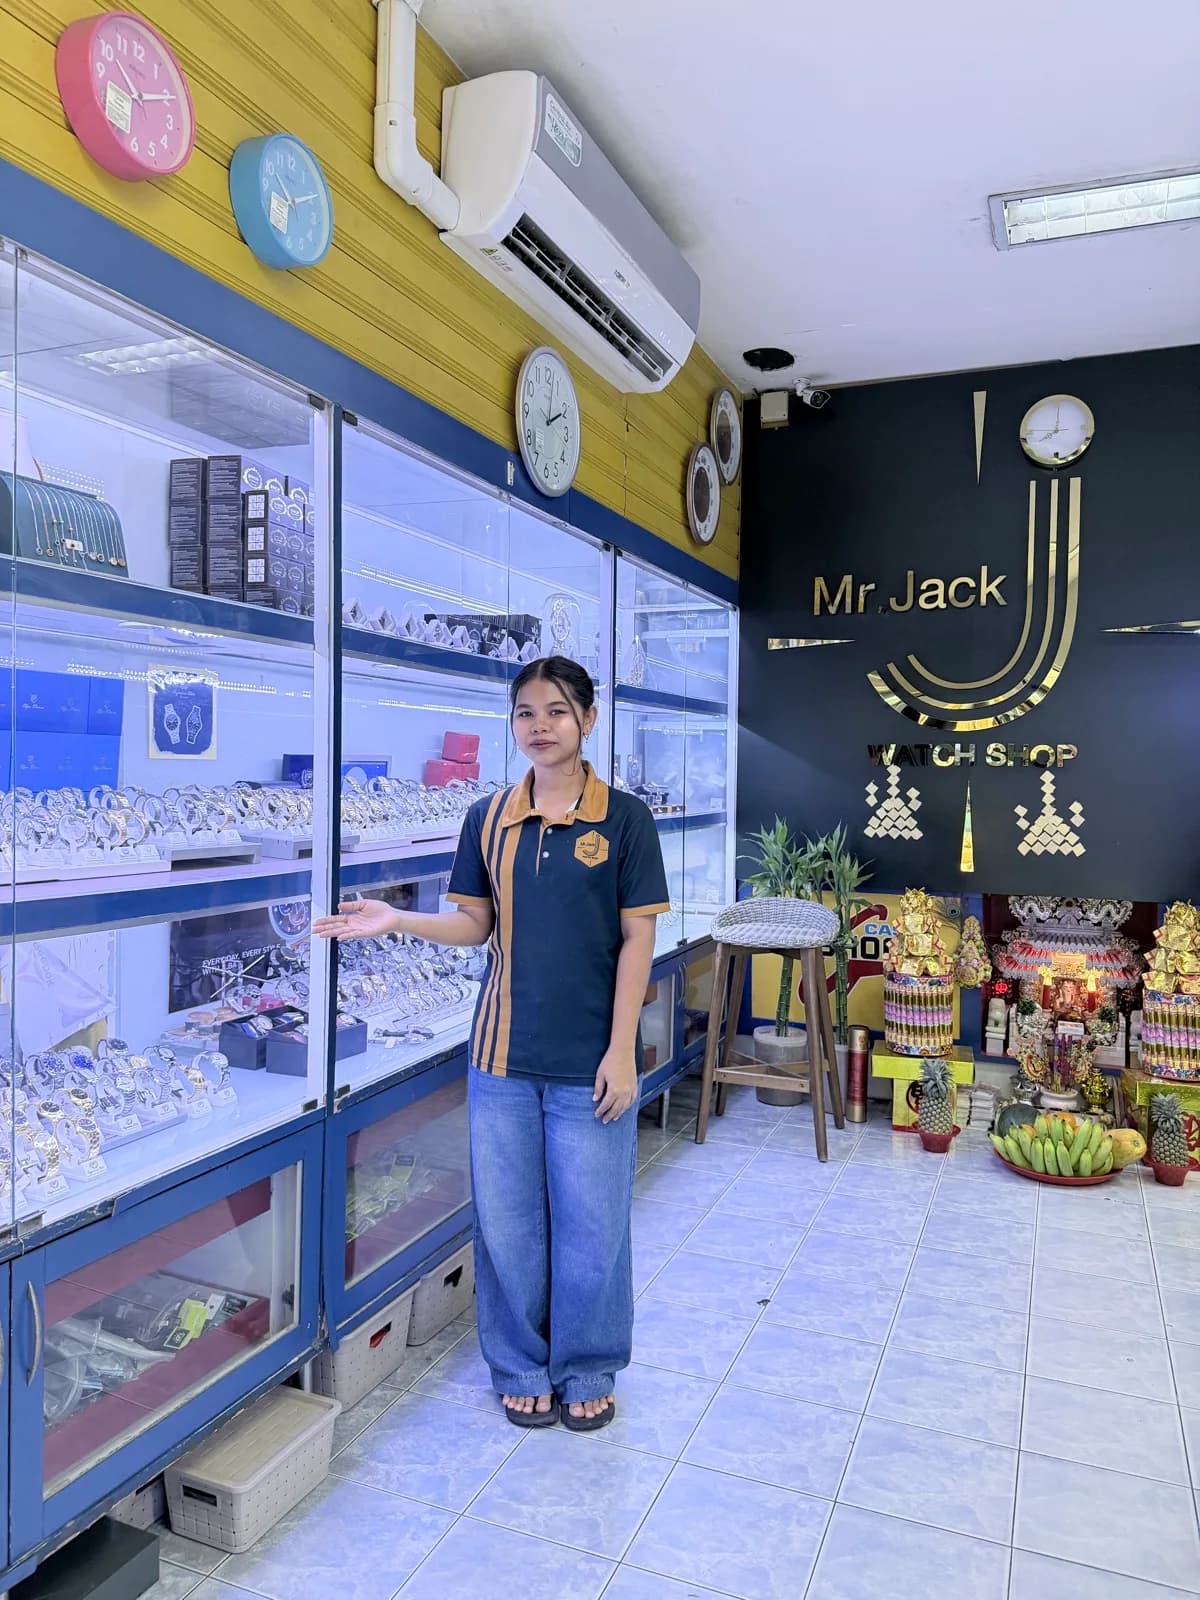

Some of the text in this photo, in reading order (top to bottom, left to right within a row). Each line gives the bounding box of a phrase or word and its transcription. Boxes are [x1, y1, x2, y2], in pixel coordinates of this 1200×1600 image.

[100, 39, 114, 61] 10
[115, 34, 128, 55] 11
[132, 40, 145, 63] 12
[96, 62, 106, 78] 9
[153, 63, 159, 80] 1
[165, 114, 174, 130] 3
[130, 136, 139, 152] 6
[147, 141, 156, 157] 5
[160, 134, 169, 149] 4
[265, 159, 275, 176] 10
[535, 365, 541, 384] 11
[544, 366, 552, 386] 12
[526, 378, 535, 398] 10
[523, 402, 530, 419] 9
[561, 402, 568, 419] 2
[526, 428, 532, 446] 8
[564, 426, 570, 443] 3
[533, 450, 539, 466] 7
[560, 450, 566, 464] 4
[543, 463, 549, 479] 6
[553, 462, 559, 478] 5
[889, 565, 1008, 612] Jack
[867, 742, 1079, 768] WATCH SHOP
[242, 949, 261, 959] EVERY
